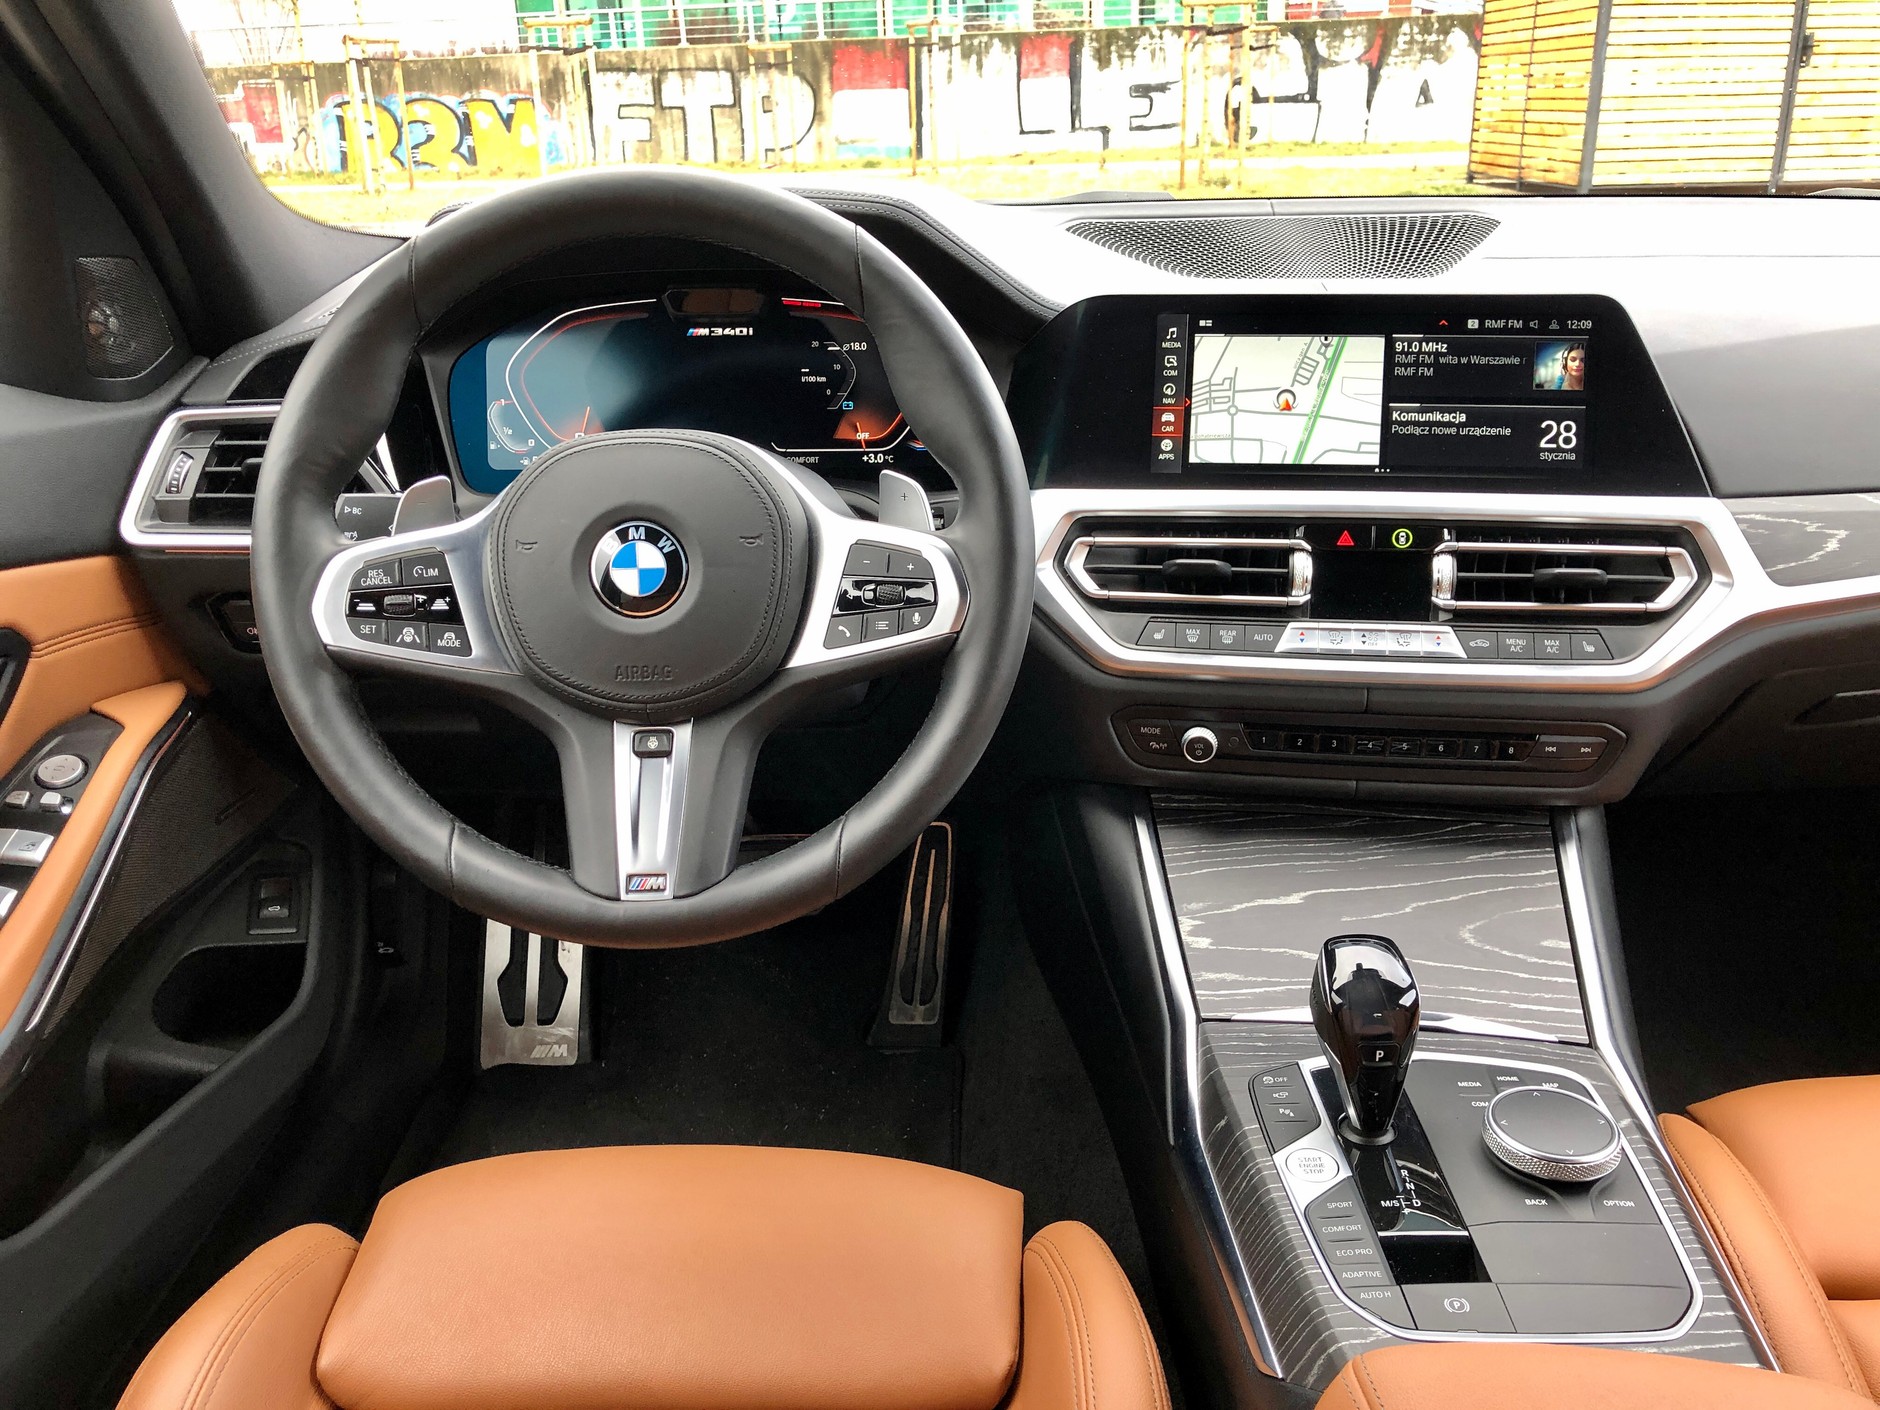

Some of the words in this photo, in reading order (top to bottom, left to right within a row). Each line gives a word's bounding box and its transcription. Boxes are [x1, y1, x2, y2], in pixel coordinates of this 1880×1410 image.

[1485, 320, 1506, 329] RMF
[1509, 320, 1523, 329] FM
[1567, 320, 1592, 329] 12:09
[1395, 341, 1419, 352] 91.0
[1422, 342, 1448, 353] MHz
[1395, 354, 1417, 364] RMF
[1419, 355, 1434, 364] FM
[1439, 355, 1458, 364] wita
[1460, 356, 1467, 364] w
[1470, 355, 1520, 365] Warszawie
[1163, 369, 1178, 377] COM
[1394, 367, 1416, 376] RMF
[1418, 367, 1434, 377] FM
[1392, 411, 1466, 424] Komunikacja
[1391, 424, 1430, 435] Podłącz
[1431, 427, 1457, 435] nowe
[1459, 425, 1512, 437] urządzenie
[1539, 420, 1577, 449] 28
[856, 432, 870, 440] OFF
[862, 453, 884, 463] +3.0
[1158, 453, 1175, 461] APPS
[1539, 451, 1576, 462] stycznia
[352, 506, 363, 515] BC
[601, 526, 676, 556] BMW
[368, 569, 384, 578] RES
[423, 568, 439, 577] LIM
[360, 577, 393, 587] CANCEL
[360, 625, 377, 634] SET
[1219, 629, 1237, 637] REAR
[1253, 633, 1274, 641] AUTO
[437, 639, 462, 648] MODE
[1506, 638, 1527, 646] MENU
[1510, 645, 1523, 653] A/C
[1546, 646, 1560, 654] A/C
[614, 664, 674, 682] AIRBAG
[1140, 726, 1161, 735] MODE
[1297, 738, 1303, 746] 2
[1331, 740, 1337, 748] 3
[1438, 744, 1444, 752] 6
[1473, 745, 1479, 753] 7
[1508, 746, 1514, 754] 8
[1375, 1050, 1385, 1062] P
[1400, 1169, 1410, 1177] R
[1405, 1182, 1415, 1190] N
[1326, 1201, 1353, 1209] SPORT
[1380, 1199, 1400, 1208] M/S
[1412, 1199, 1422, 1207] D
[1524, 1198, 1549, 1206] BACK
[1603, 1199, 1636, 1208] OPTION
[1322, 1224, 1362, 1234] COMFORT
[1335, 1248, 1354, 1257] ECO
[1355, 1248, 1373, 1256] PRO
[1341, 1270, 1383, 1279] ADAPTIVE
[1360, 1291, 1383, 1299] AUTO
[1384, 1290, 1392, 1298] H
